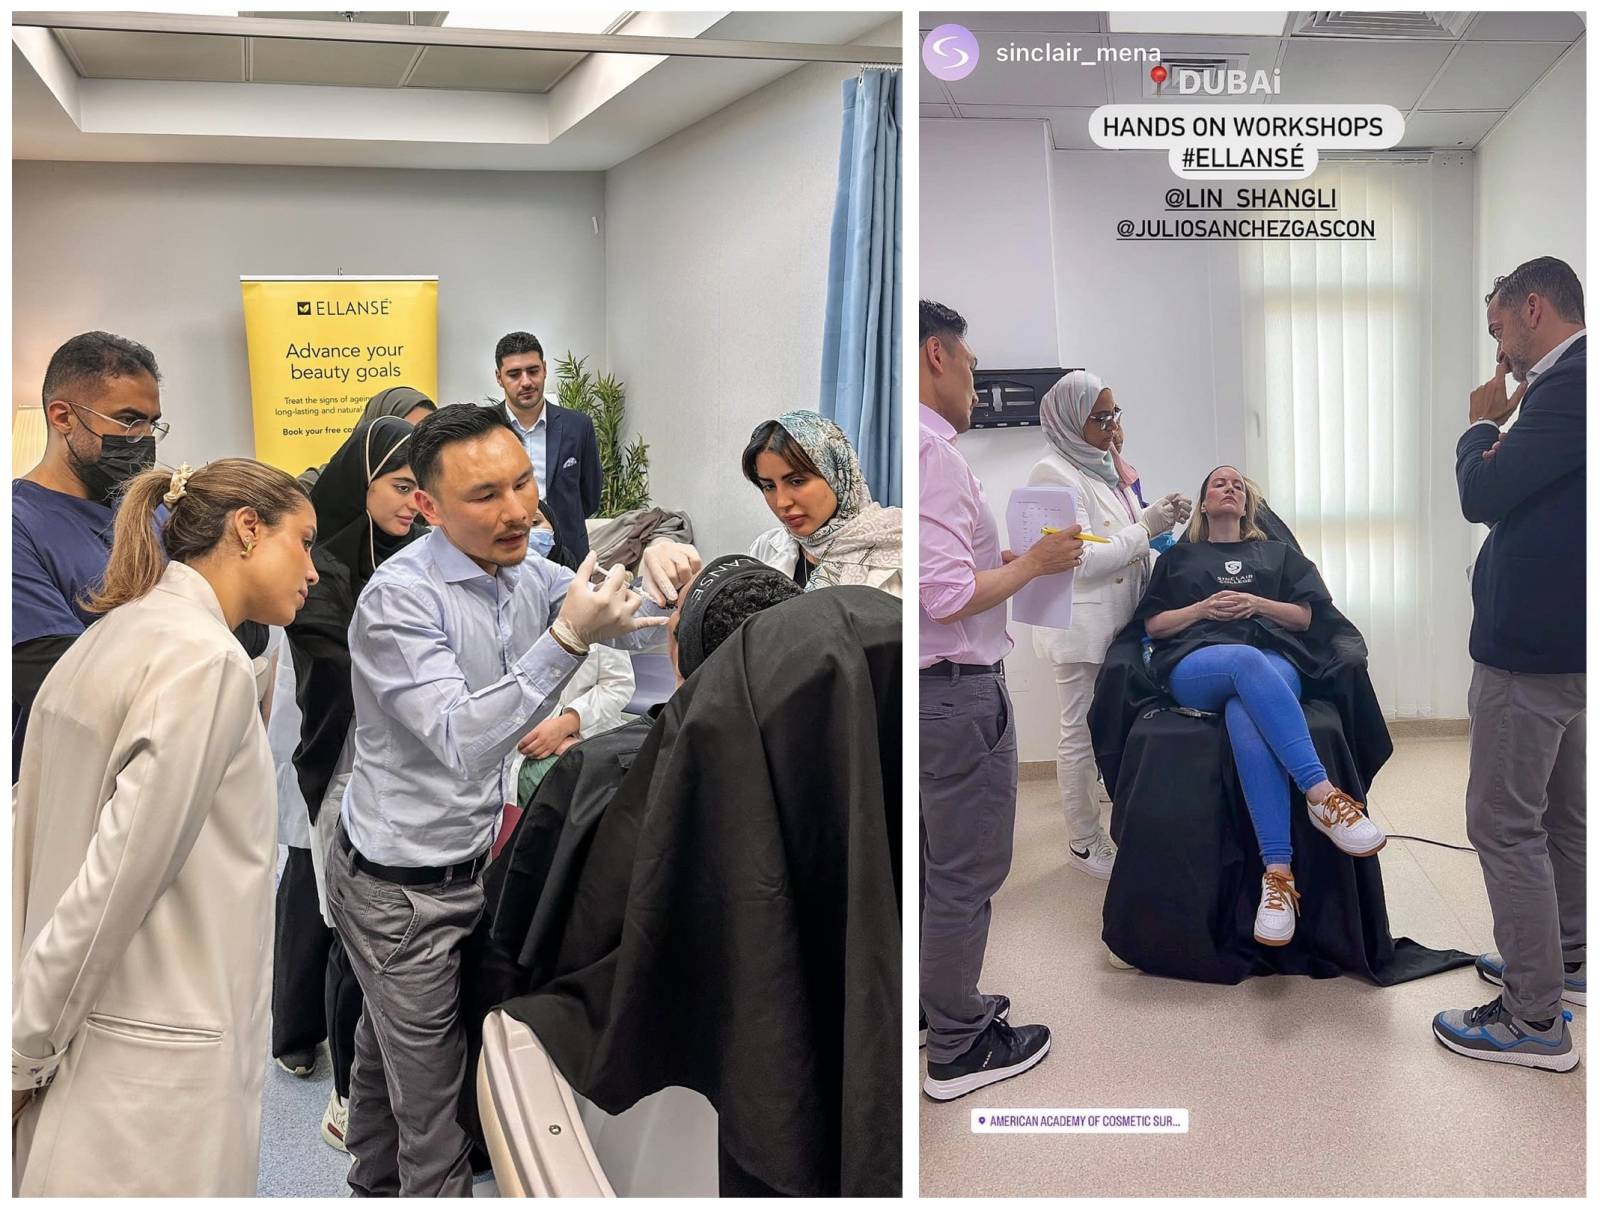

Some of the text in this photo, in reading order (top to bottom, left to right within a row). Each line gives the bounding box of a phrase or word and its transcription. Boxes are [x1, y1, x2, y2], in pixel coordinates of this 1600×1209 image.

[286, 342, 404, 362] Advance your
[291, 361, 401, 383] beauty goals
[284, 395, 370, 405] Treat the signs of agein
[275, 405, 365, 417] long-lasting and natural-
[282, 427, 303, 436] Book
[305, 428, 323, 437] your
[325, 426, 341, 434] free
